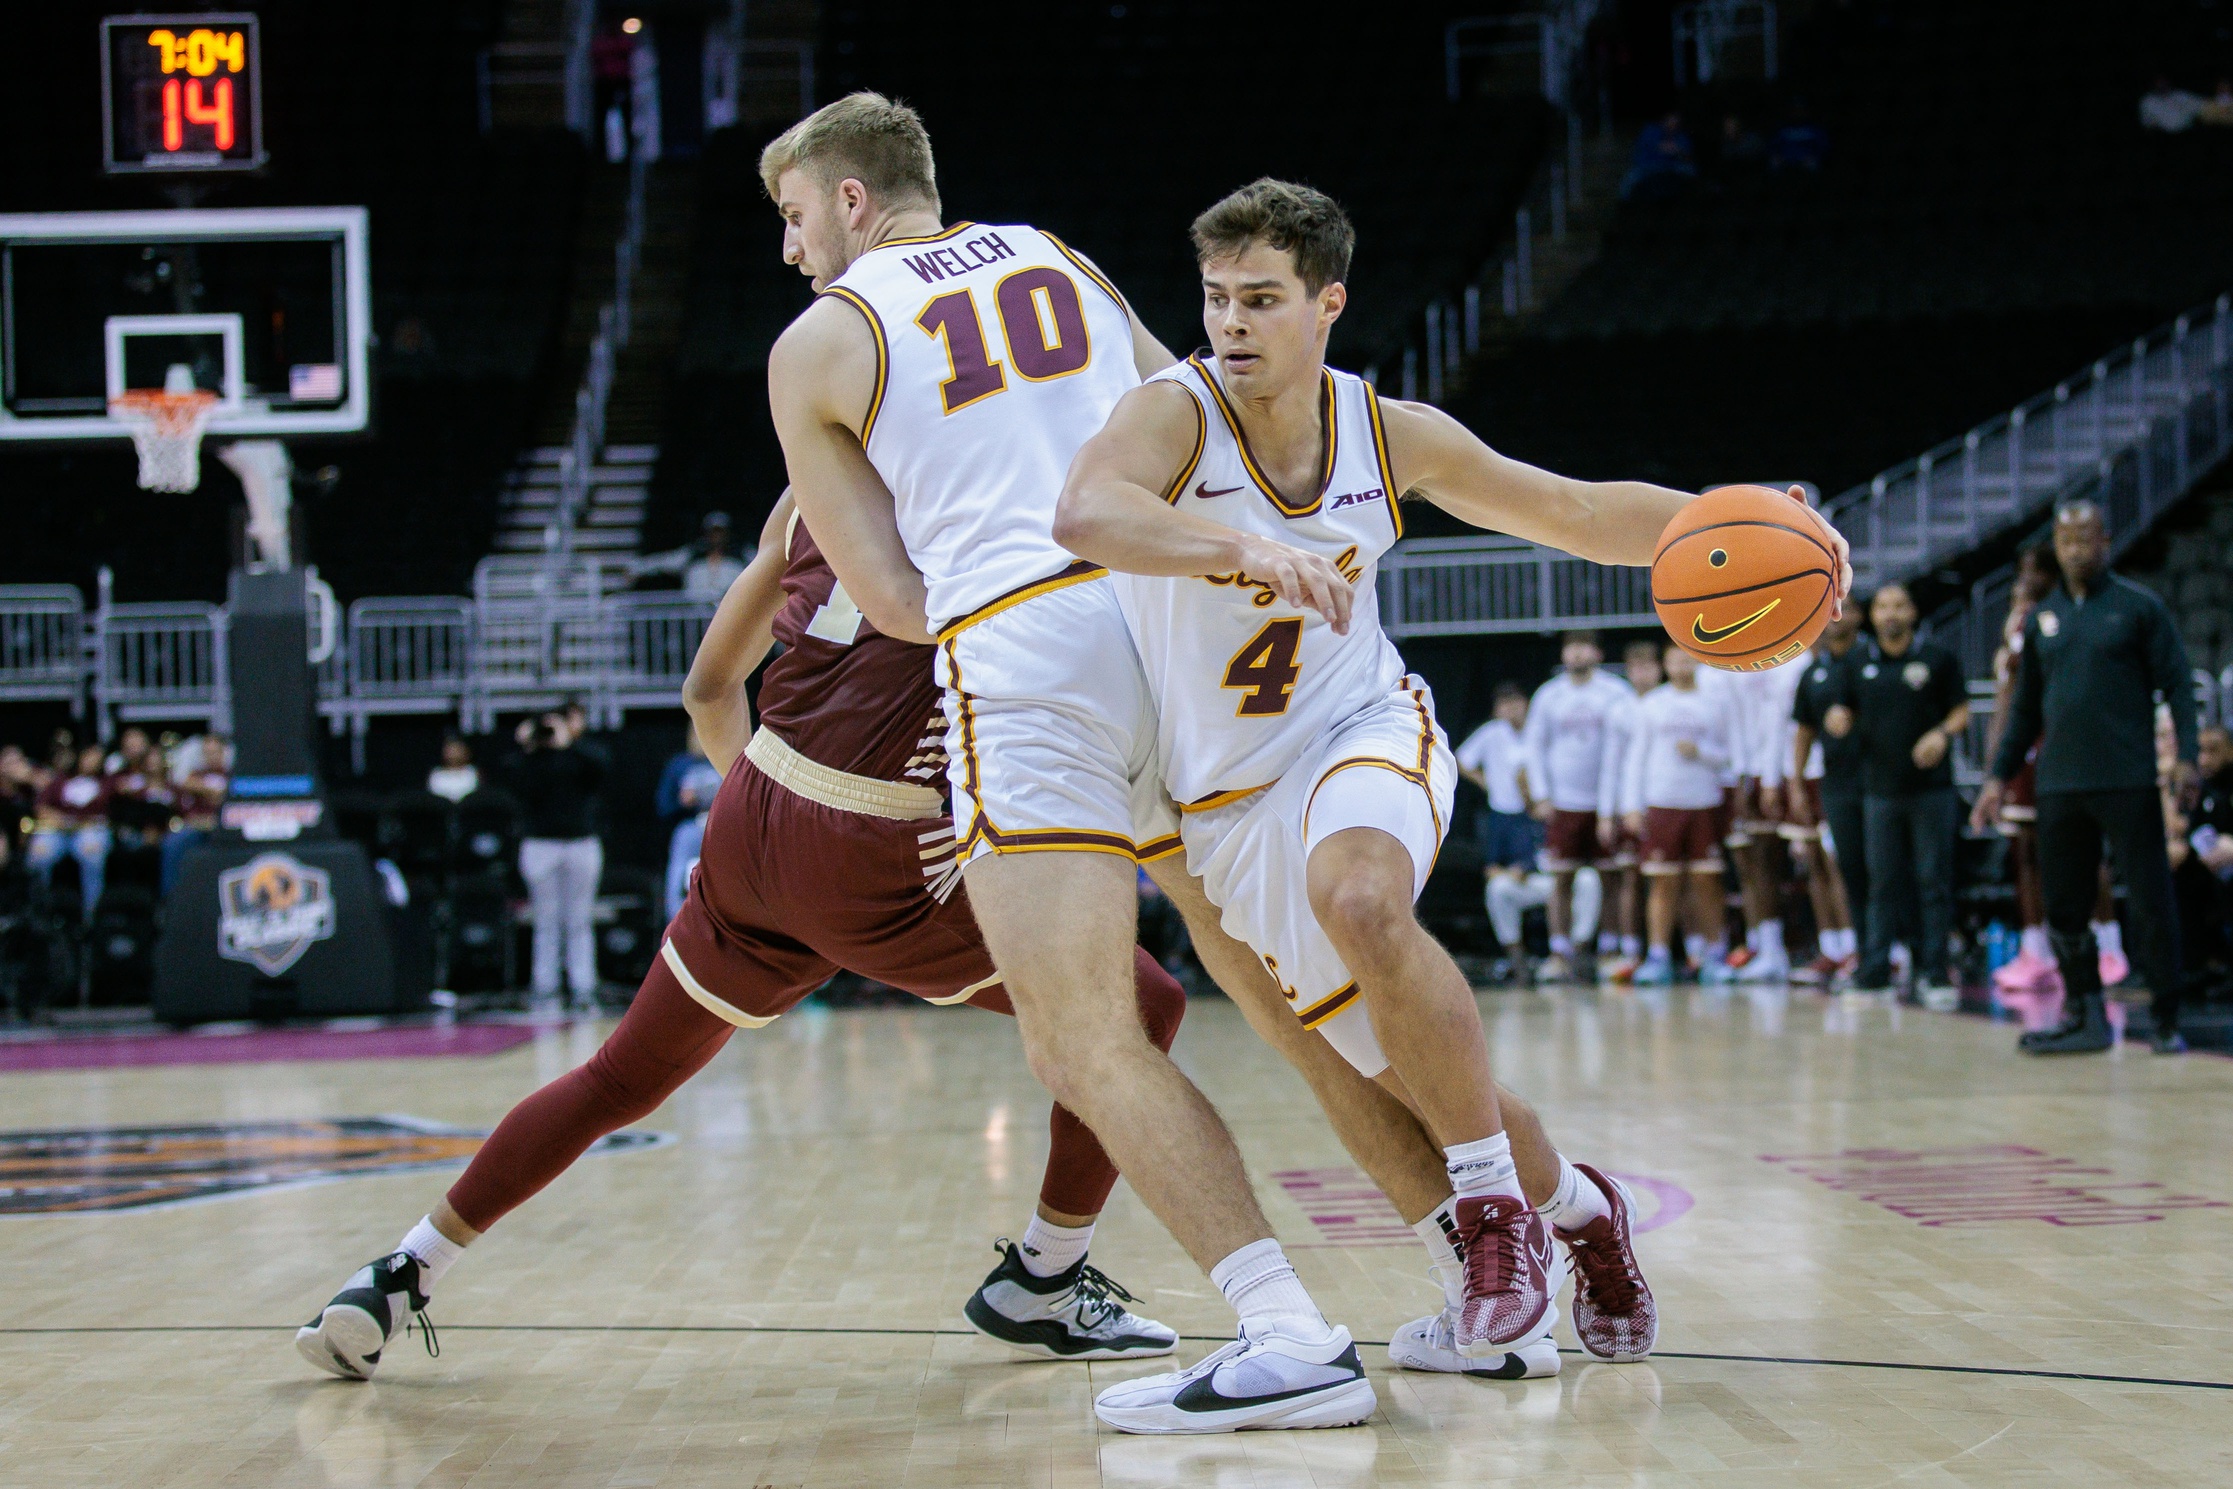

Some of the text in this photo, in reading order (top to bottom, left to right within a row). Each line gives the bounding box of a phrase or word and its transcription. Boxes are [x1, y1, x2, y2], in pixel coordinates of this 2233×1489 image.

[148, 29, 244, 76] 7:04
[162, 78, 234, 151] 14
[902, 232, 1016, 284] WELCH
[913, 265, 1092, 417] 10
[1330, 488, 1383, 510] A10
[1220, 616, 1305, 718] 4
